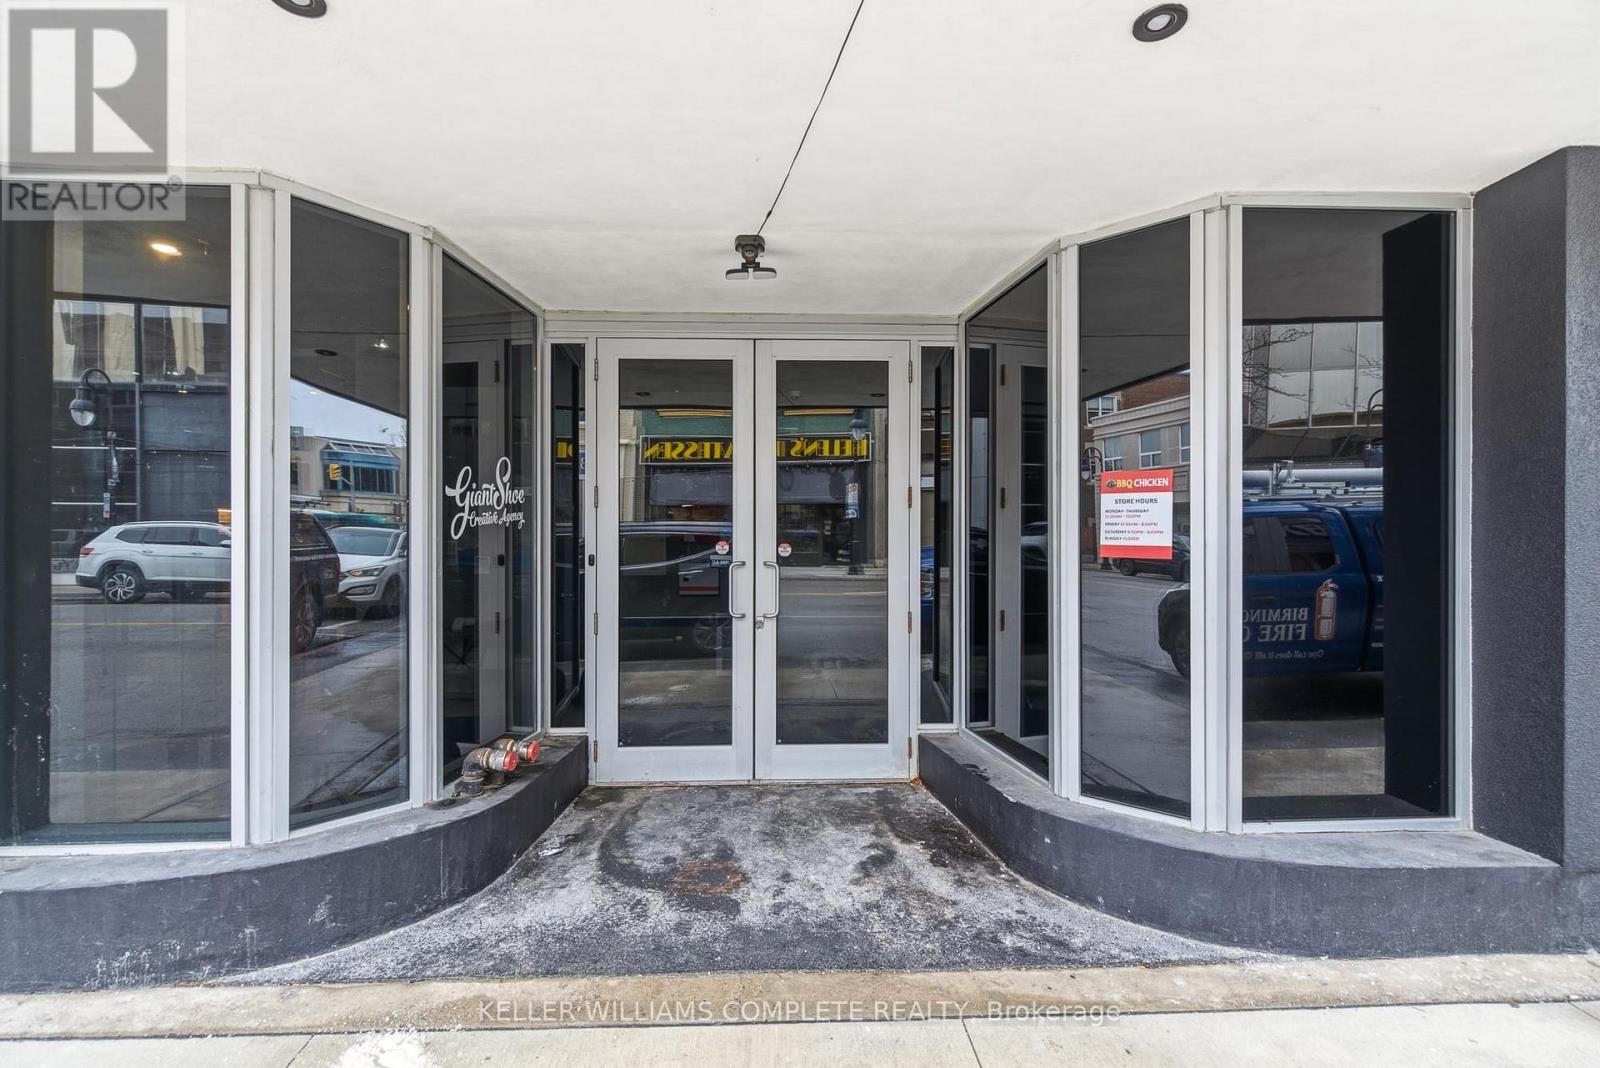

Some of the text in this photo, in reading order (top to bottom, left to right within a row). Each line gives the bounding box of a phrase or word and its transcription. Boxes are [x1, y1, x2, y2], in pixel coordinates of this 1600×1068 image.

[1116, 478, 1168, 488] BBQ CHICKEN
[445, 457, 525, 540] Giant Shoe
[469, 508, 525, 529] Creative Agency
